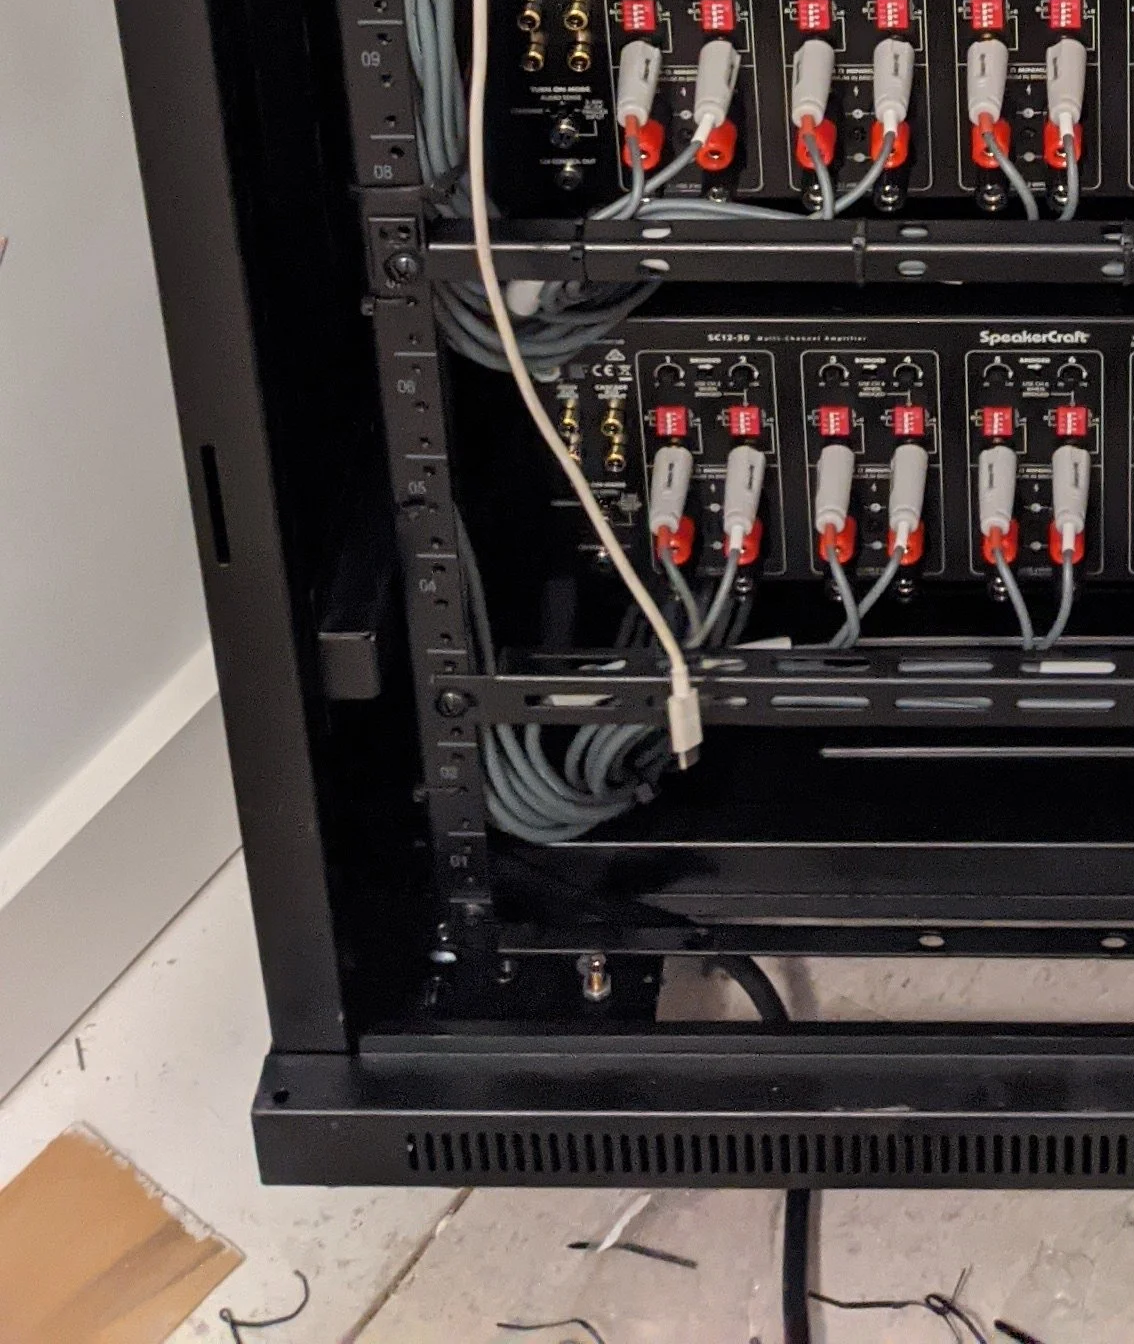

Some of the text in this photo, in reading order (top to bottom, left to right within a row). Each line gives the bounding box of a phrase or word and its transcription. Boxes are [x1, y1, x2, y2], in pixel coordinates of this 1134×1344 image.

[361, 51, 380, 66] 09
[374, 165, 393, 179] 08
[979, 330, 1090, 345] SpeakerCraft
[397, 380, 415, 394] 06
[407, 480, 427, 495] 05
[418, 579, 437, 593] 04
[439, 766, 458, 780] 02
[449, 854, 468, 868] 01
